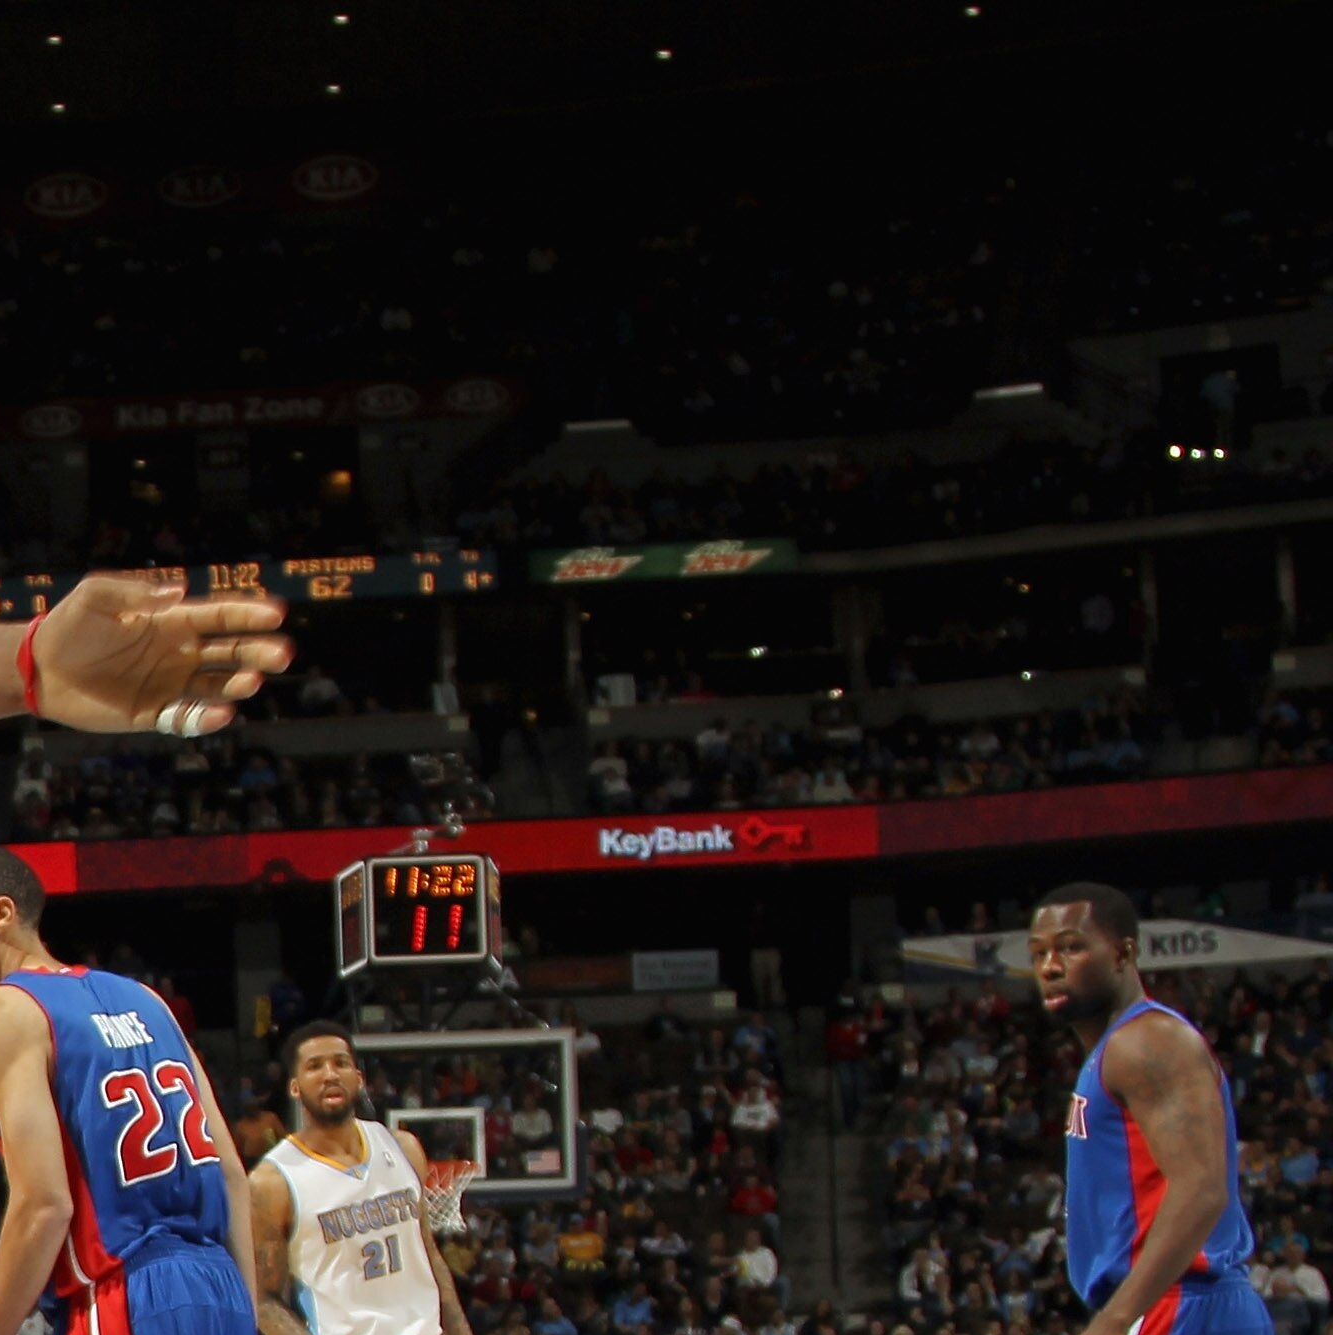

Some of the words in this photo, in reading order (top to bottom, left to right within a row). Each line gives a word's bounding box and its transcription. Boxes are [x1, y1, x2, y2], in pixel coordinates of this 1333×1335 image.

[309, 166, 364, 189] KIA
[39, 182, 92, 206] KIA
[116, 402, 167, 427] Kia
[177, 400, 233, 424] Fan
[244, 396, 325, 421] Zone
[208, 563, 261, 589] 11:22
[283, 554, 376, 577] PISTONS
[307, 574, 353, 601] 62
[598, 822, 734, 861] KeyBank
[383, 863, 477, 898] 11:22
[409, 903, 465, 953] 11
[1149, 930, 1219, 957] KIDS
[101, 1060, 220, 1186] 22
[317, 1189, 419, 1244] NUGGETS
[362, 1233, 403, 1281] 21
